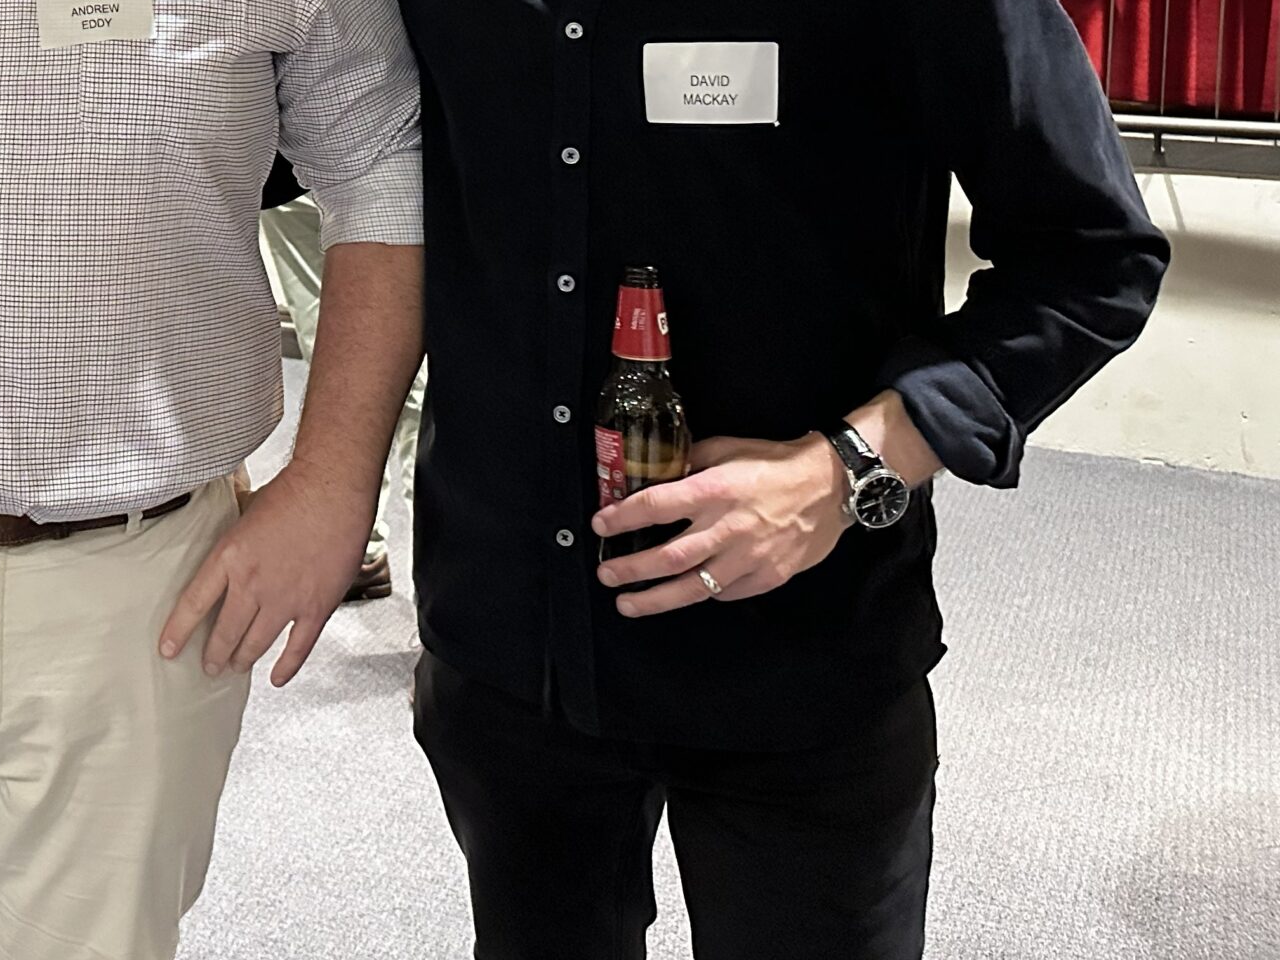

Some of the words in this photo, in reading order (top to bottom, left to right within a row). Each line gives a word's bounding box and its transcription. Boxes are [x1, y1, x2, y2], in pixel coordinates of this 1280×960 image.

[71, 3, 120, 17] ANDREW
[81, 18, 113, 30] EDDY
[690, 75, 730, 87] DAVID
[683, 93, 738, 106] MACKAY
